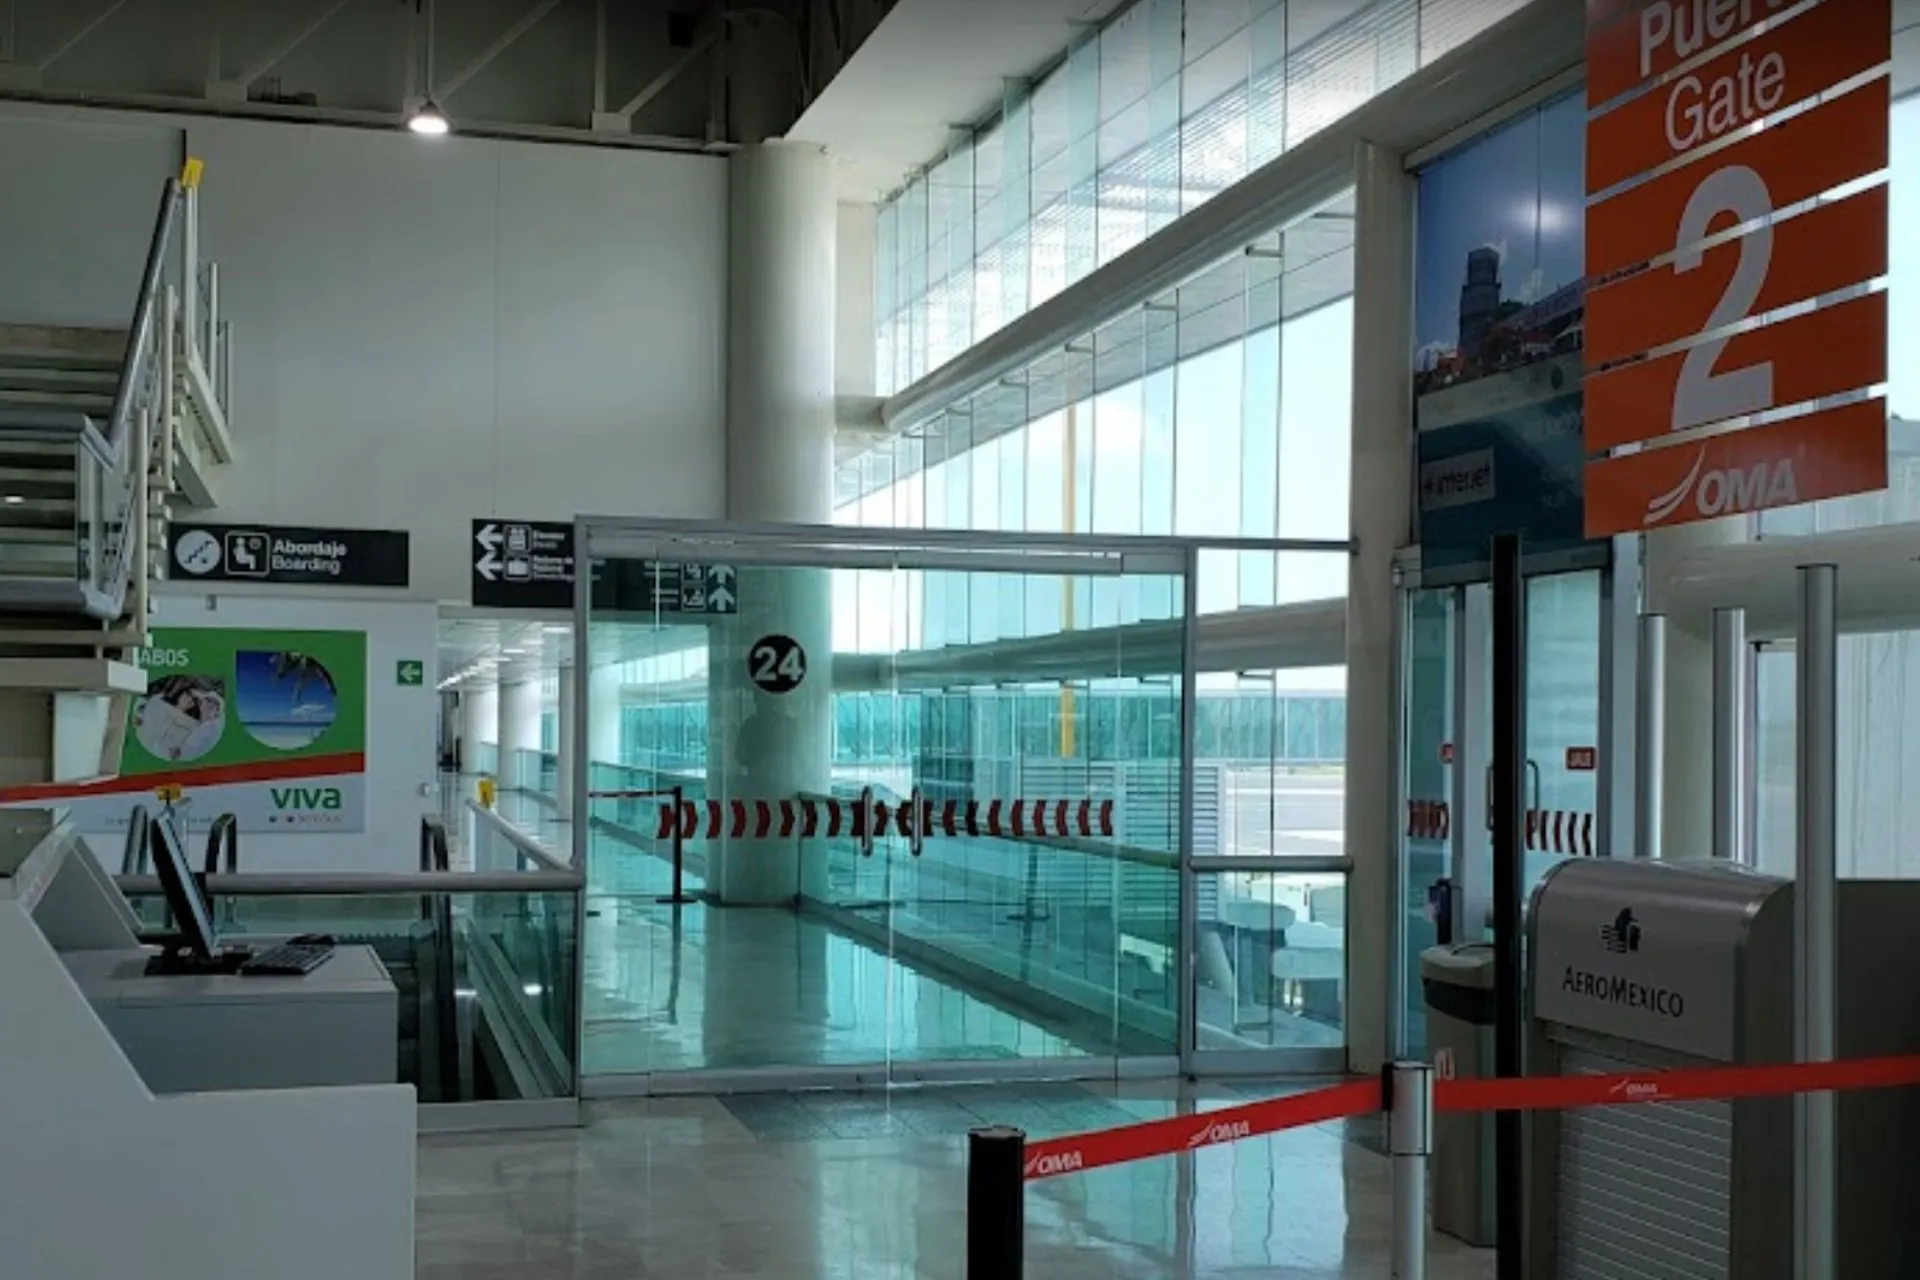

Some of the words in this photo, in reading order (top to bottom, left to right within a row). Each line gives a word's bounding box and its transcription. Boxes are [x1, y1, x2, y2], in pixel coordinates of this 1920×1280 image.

[1665, 52, 1786, 150] Gate
[1672, 165, 1774, 431] 2
[1696, 458, 1798, 515] OMA
[273, 539, 347, 558] Abordaje
[272, 556, 341, 574] Boarding
[142, 649, 190, 667] ABOS
[753, 646, 803, 681] 24
[1210, 1121, 1250, 1141] OMA
[1037, 1151, 1082, 1174] OMA
